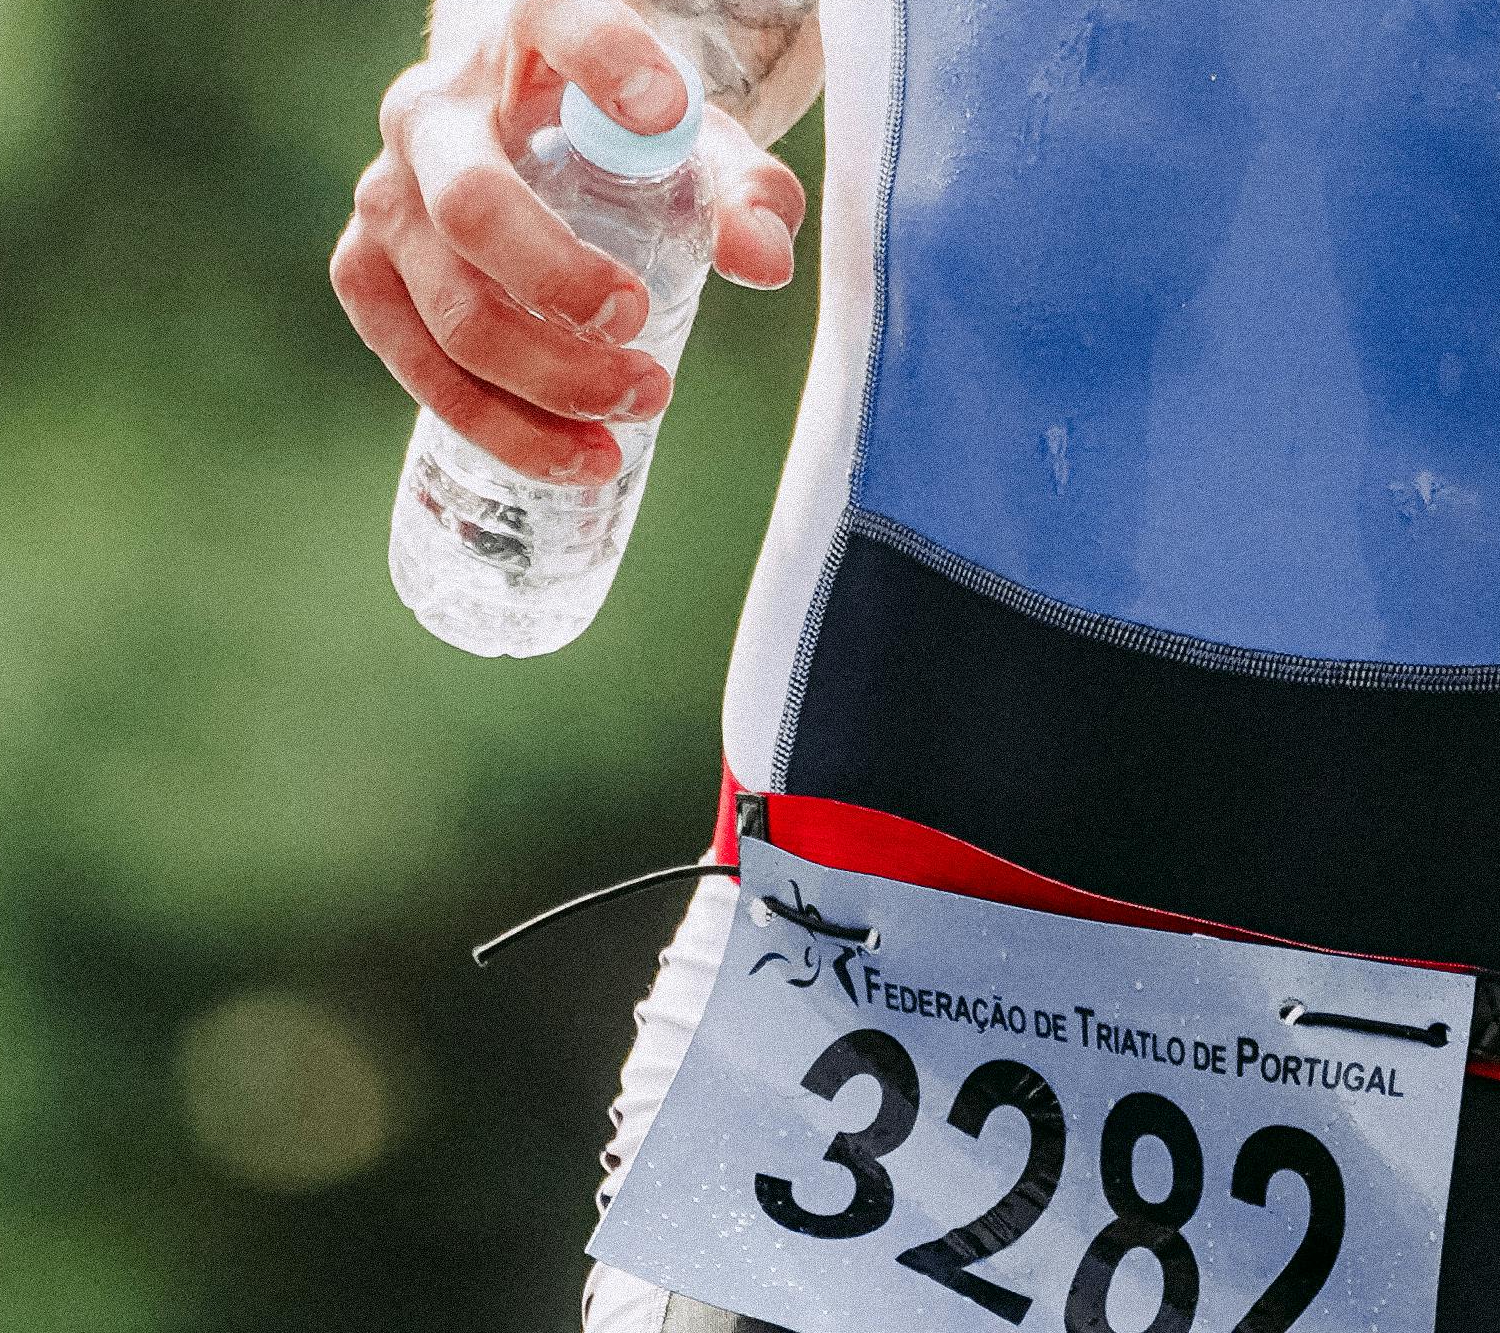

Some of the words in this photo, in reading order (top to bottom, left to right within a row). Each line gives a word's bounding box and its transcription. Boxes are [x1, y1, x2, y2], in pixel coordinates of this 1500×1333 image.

[864, 967, 1028, 1034] FEDERAÇÃO
[1035, 1010, 1068, 1042] DE
[1074, 1006, 1186, 1067] TRIATLO
[1193, 1041, 1227, 1075] DE
[1236, 1037, 1404, 1098] PORTUGAL
[754, 1028, 1346, 1333] 3282
